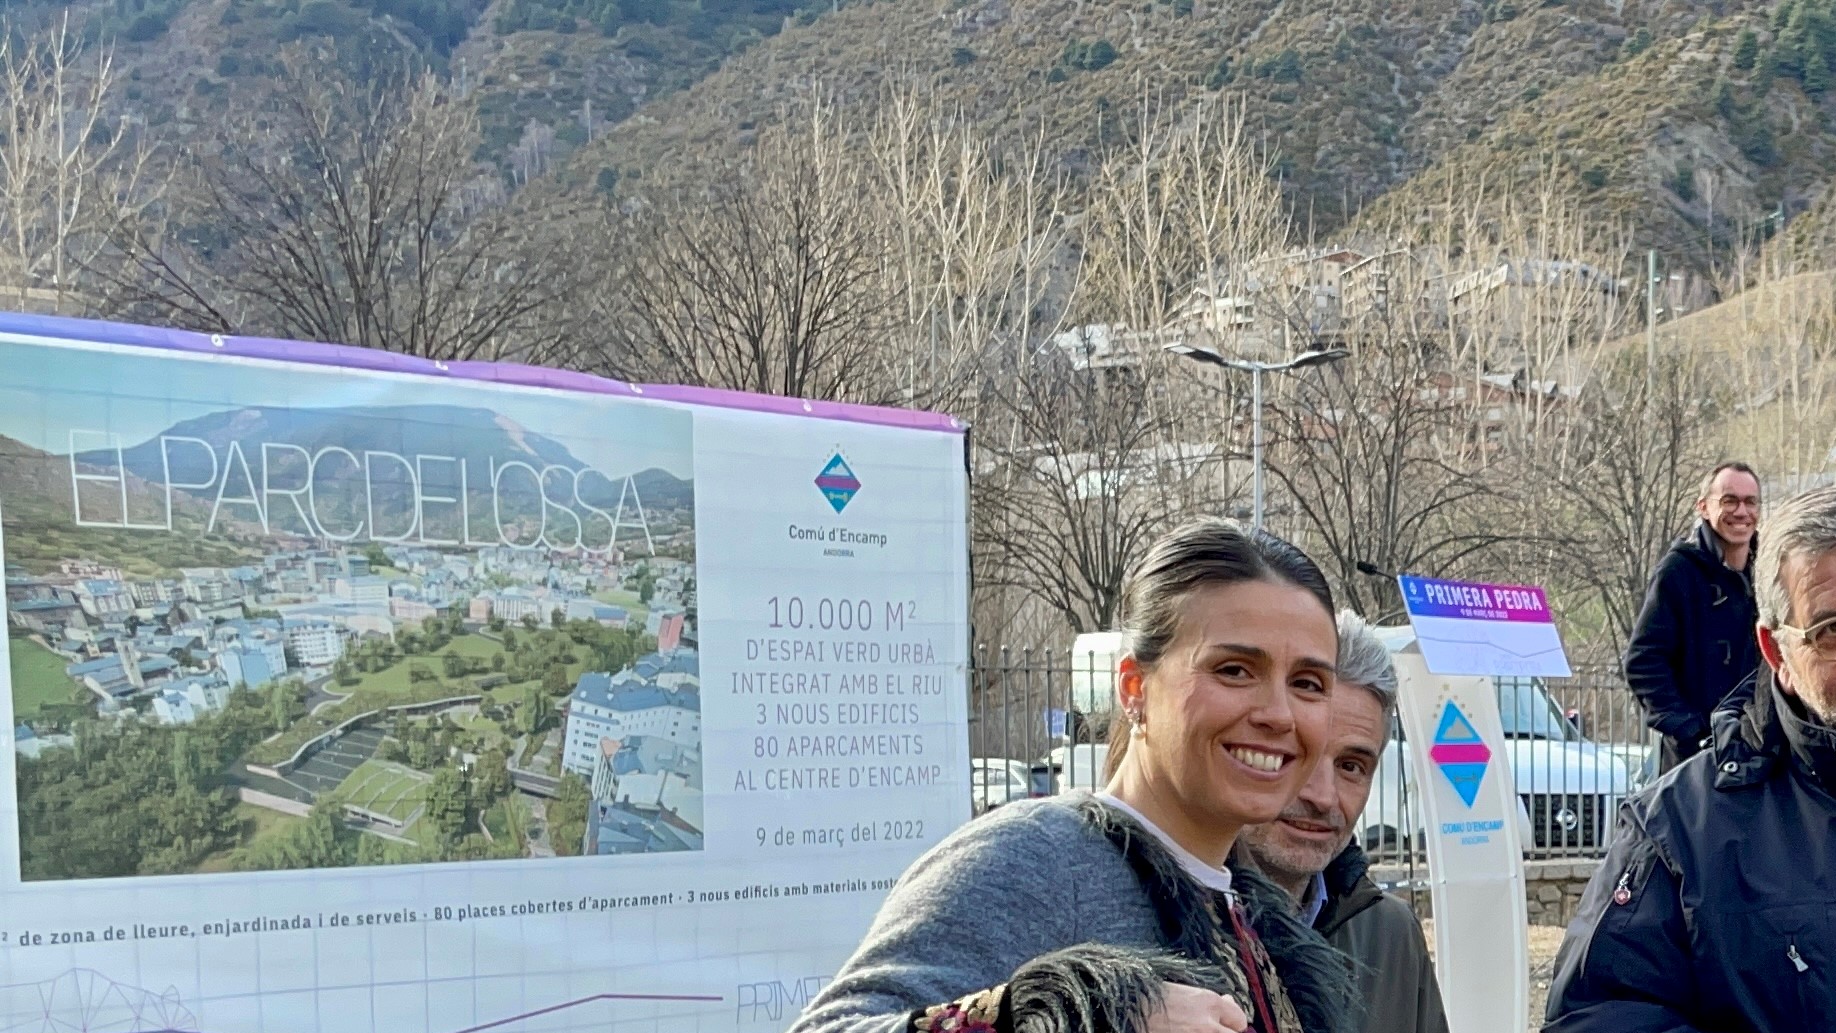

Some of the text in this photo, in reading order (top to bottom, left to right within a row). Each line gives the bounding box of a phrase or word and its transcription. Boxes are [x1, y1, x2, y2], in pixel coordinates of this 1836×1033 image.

[788, 524, 888, 548] Comú d'Encamp
[823, 548, 855, 558] ANDORRA
[1424, 583, 1543, 611] PRIMERA PEDRA
[768, 596, 872, 631] 10.000
[746, 638, 935, 664] D'ESPAI VERD URBÀ
[731, 672, 942, 695] INTEGRAT AMB EL RIU
[756, 703, 919, 725] 3 NOUS EDIFICIS
[754, 735, 924, 758] 80 APARCAMENTS
[734, 765, 941, 791] AL CENTRE D'ENCAMP
[756, 819, 924, 848] 9 de març del 2022
[19, 930, 42, 947] de
[50, 929, 95, 945] zona
[103, 925, 126, 942] de
[133, 923, 196, 940] lleure,
[203, 915, 312, 937] enjardinada
[318, 912, 323, 928] i
[330, 912, 350, 927] de
[356, 908, 417, 926] serveis
[433, 905, 453, 921] 80
[457, 903, 506, 922] places
[511, 899, 574, 916] cobertes
[578, 892, 674, 912] d'aparcament
[687, 890, 695, 903] 3
[699, 890, 730, 902] nous
[734, 885, 780, 900] edificis
[783, 882, 809, 897] amb
[812, 879, 868, 894] materials
